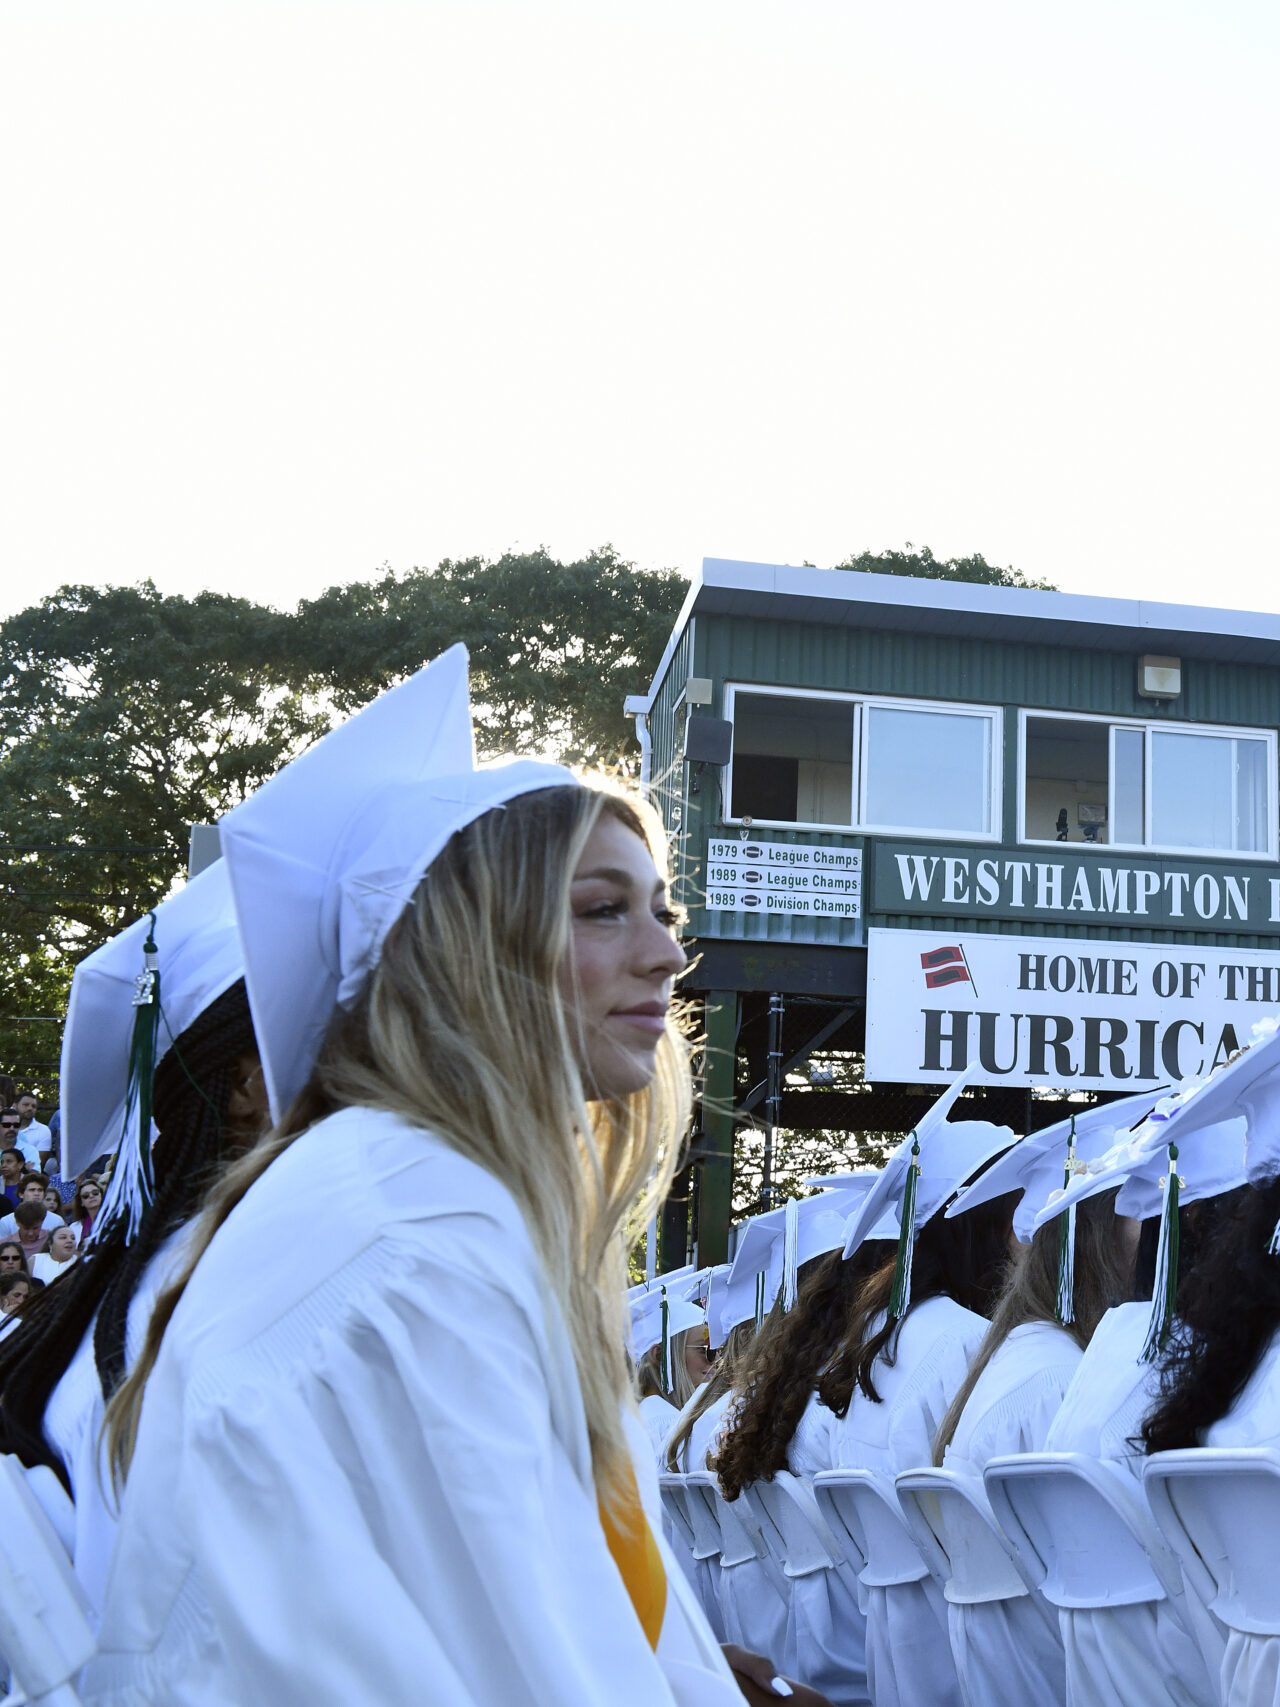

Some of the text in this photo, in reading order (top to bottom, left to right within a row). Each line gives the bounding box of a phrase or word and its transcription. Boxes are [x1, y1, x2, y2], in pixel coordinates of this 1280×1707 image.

[711, 844, 859, 868] 1979 League Champs
[710, 868, 858, 892] 1989 League Champs
[894, 854, 1250, 921] WESTHAMPTON
[709, 893, 858, 916] 1989 Division Champs
[1017, 953, 1138, 996] HOME
[1152, 960, 1206, 998] OF
